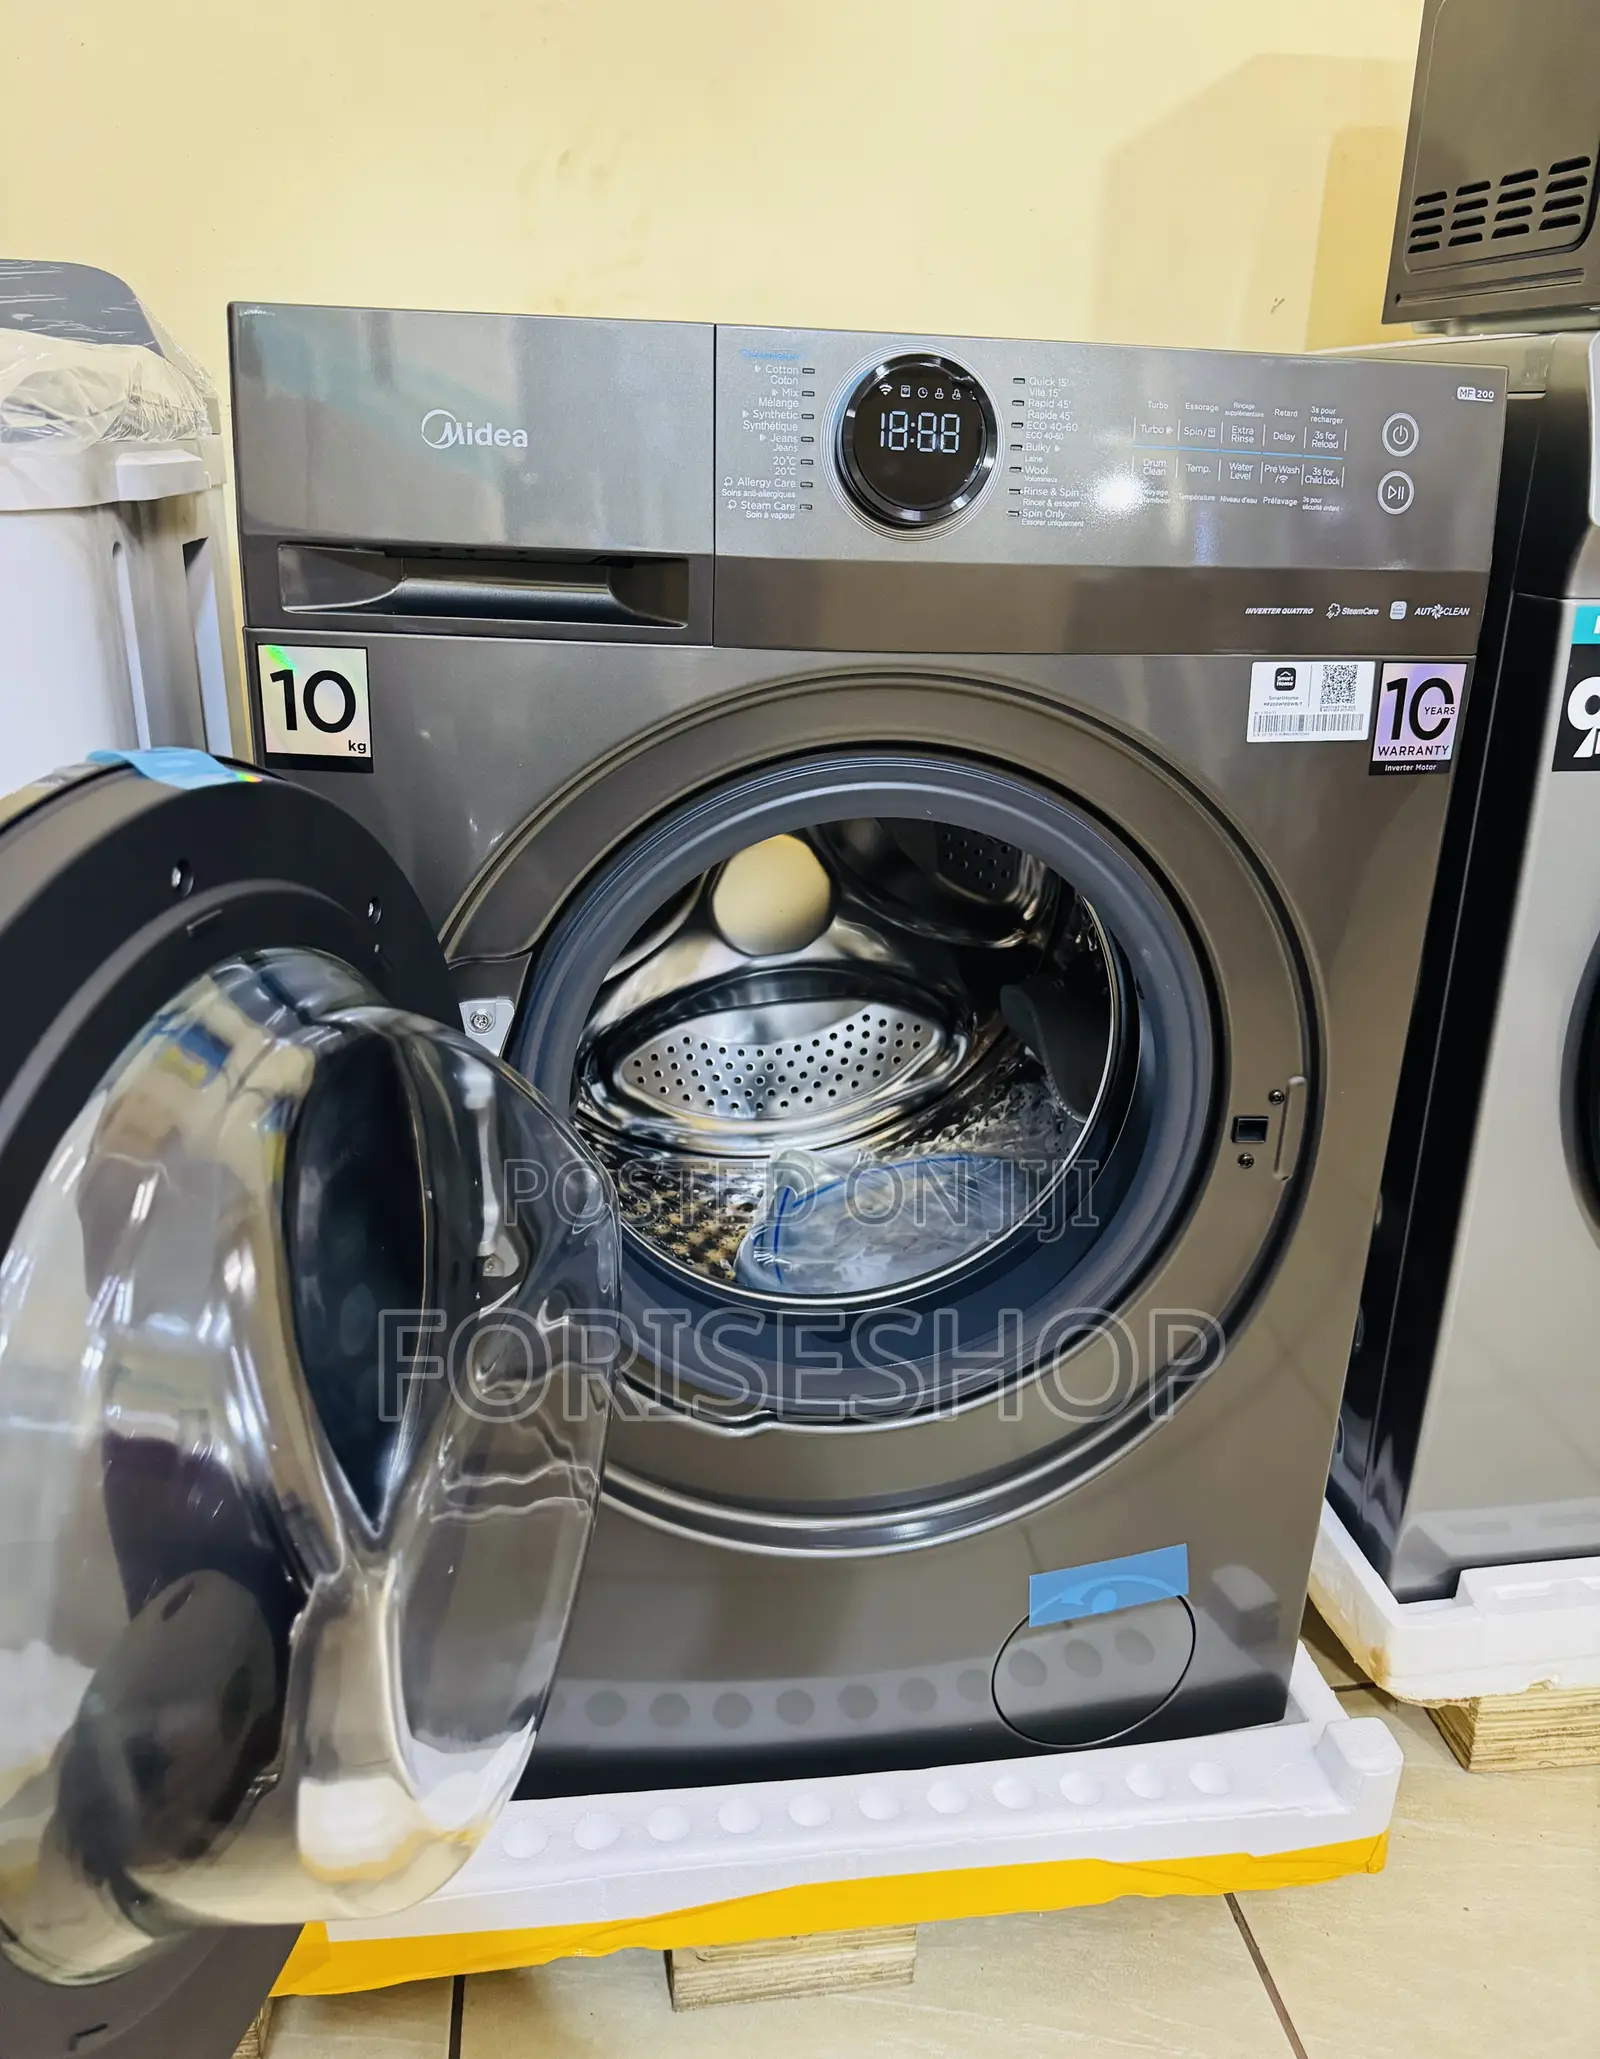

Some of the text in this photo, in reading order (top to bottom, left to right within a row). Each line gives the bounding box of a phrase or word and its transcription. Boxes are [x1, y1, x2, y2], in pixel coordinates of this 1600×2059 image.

[766, 364, 798, 374] Cotton
[770, 375, 798, 384] Coton
[1029, 377, 1055, 386] Quick
[782, 388, 798, 397] Mix
[758, 397, 799, 409] Mélange
[1028, 398, 1054, 408] Rapid
[1148, 400, 1168, 410] Turbo
[1185, 402, 1219, 412] Essorage
[752, 410, 798, 420] Synthetic
[1028, 410, 1058, 420] Rapide
[1274, 409, 1298, 418] Retard
[1310, 406, 1336, 416] 3s pour
[1310, 416, 1344, 425] recharger
[422, 410, 528, 449] Midea
[742, 420, 798, 432] Synthétique
[1026, 421, 1078, 432] ECO 40-60
[1140, 424, 1164, 434] Turbo
[1232, 426, 1254, 435] Extra
[880, 411, 960, 454] 18:88
[1026, 432, 1042, 440] ECO
[1273, 432, 1296, 442] Delay
[1314, 431, 1336, 440] 3s for
[770, 434, 798, 443] Jeans
[1231, 434, 1254, 444] Rinse
[773, 444, 798, 452] Jeans
[1026, 442, 1051, 454] Bulky
[1312, 440, 1339, 449] Reload
[1143, 459, 1166, 468] Drum
[1229, 462, 1254, 472] Water
[1024, 465, 1048, 474] Wool
[1142, 467, 1166, 476] Clean
[1186, 464, 1211, 474] Temp.
[1264, 464, 1300, 474] Pre Wash
[1312, 467, 1334, 476] 3s for
[1230, 472, 1251, 480] Level
[1304, 475, 1340, 486] Child Lock
[737, 477, 796, 488] Allergy Care
[722, 488, 742, 496] Soins
[1024, 487, 1080, 498] Rinse & Spin
[740, 500, 796, 510] Steam Care
[1220, 496, 1240, 504] Niveau
[1262, 496, 1298, 507] Prélavage
[746, 510, 762, 518] Soin
[1022, 508, 1066, 520] Spin Only
[1341, 607, 1380, 616] SteamCare
[270, 669, 356, 733] 10
[1386, 678, 1455, 740] 10
[1424, 706, 1456, 716] YEARS
[348, 740, 366, 753] kg
[1378, 745, 1450, 756] WARRANTY
[1384, 764, 1414, 772] Inverter
